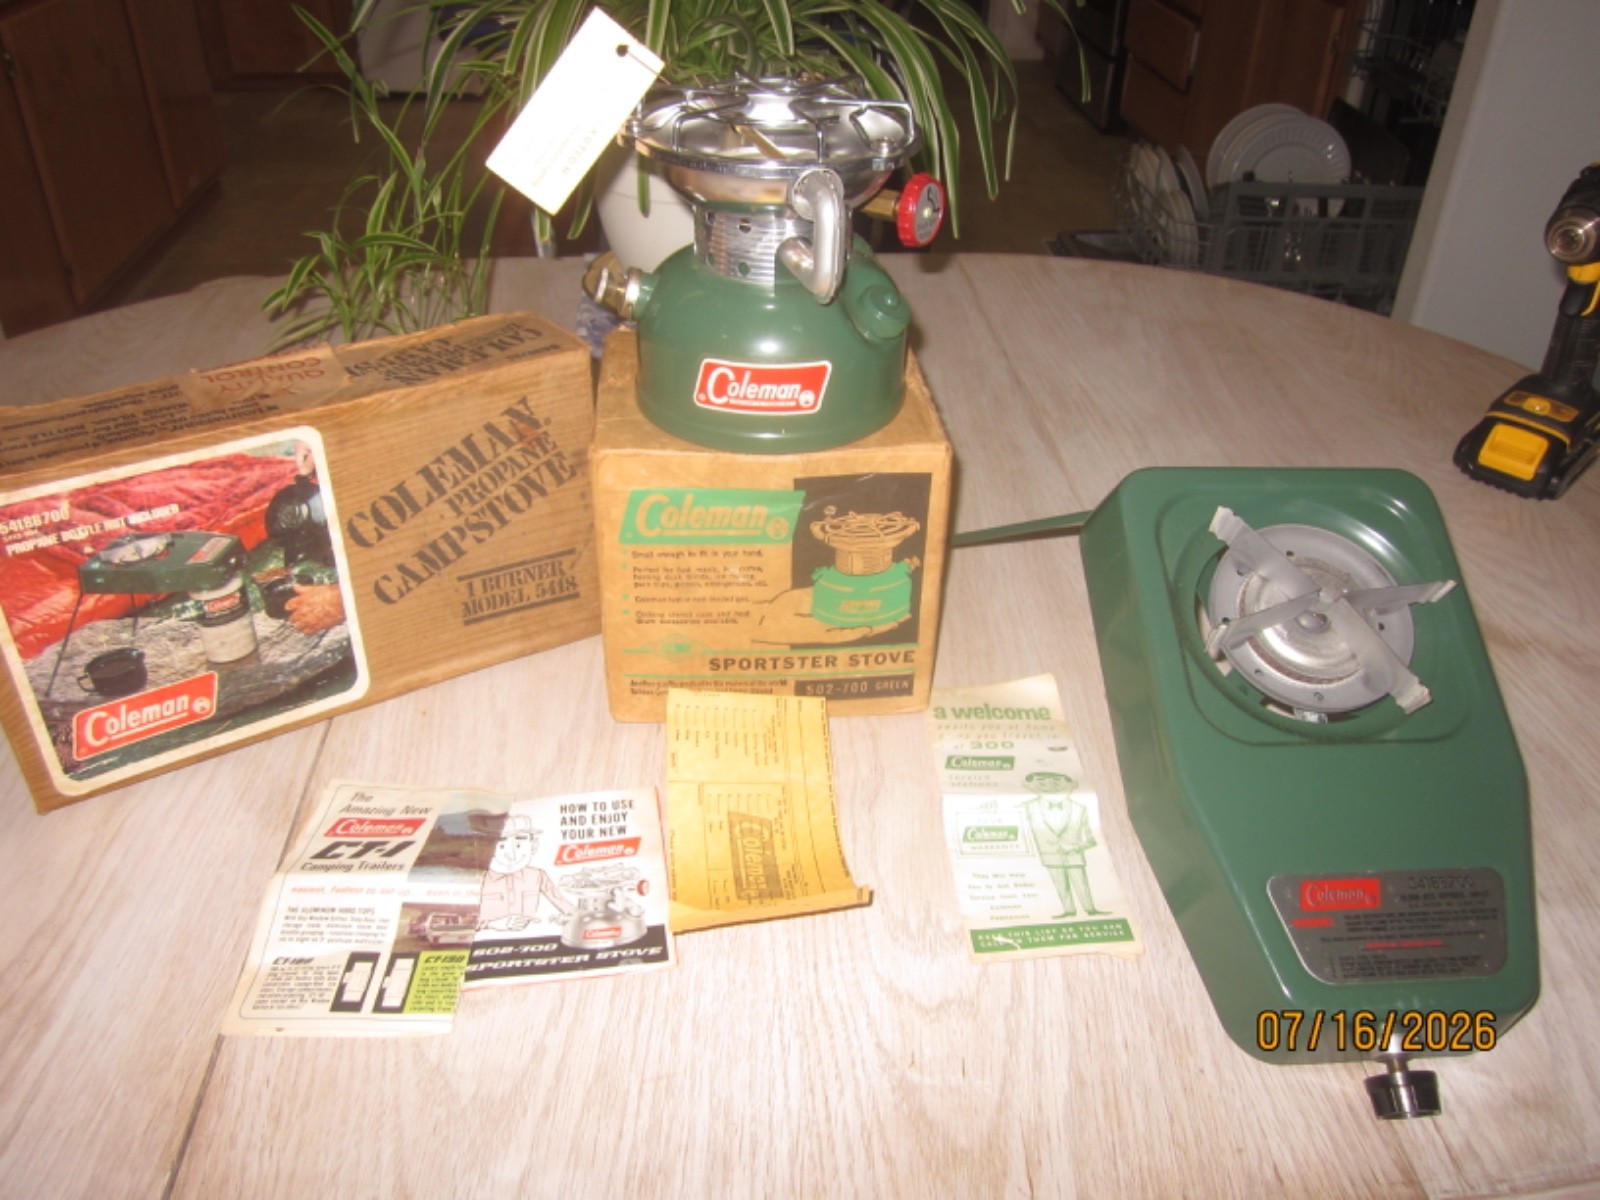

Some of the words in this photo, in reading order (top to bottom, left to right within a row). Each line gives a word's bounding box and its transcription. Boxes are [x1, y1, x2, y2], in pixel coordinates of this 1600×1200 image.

[706, 366, 801, 406] Coleman
[346, 396, 543, 549] COLEMAN
[446, 431, 558, 518] PROPANE
[636, 494, 767, 537] Coleman
[373, 451, 578, 605] CAMPSTOVE
[6, 533, 59, 557] PROPANE
[466, 581, 476, 598] 1
[480, 560, 567, 594] BURNER
[462, 589, 530, 618] MODEL
[535, 576, 578, 599] 5418
[709, 656, 837, 672] SPORTSTER
[848, 650, 915, 667] STOVE
[806, 681, 869, 696] 502-700
[84, 694, 190, 746] Coleman
[933, 706, 948, 721] a
[951, 703, 1052, 721] welcome
[950, 757, 1001, 769] Coleman
[350, 791, 375, 803] The
[560, 803, 588, 814] HOW
[592, 801, 607, 812] TO
[612, 799, 635, 811] USE
[339, 803, 397, 817] Amazing
[400, 804, 433, 815] New
[560, 814, 587, 826] AND
[591, 811, 629, 824] ENJOY
[336, 819, 403, 835] Coleman
[560, 827, 595, 840] YOUR
[600, 825, 628, 838] NEW
[562, 843, 624, 861] Coleman
[735, 820, 770, 890] Coleman
[300, 861, 355, 873] Camping
[358, 860, 406, 871] Trailers
[1306, 883, 1366, 906] Coleman
[1008, 930, 1031, 938] THIS
[1034, 928, 1057, 936] LIST
[1079, 925, 1099, 933] YOU
[1060, 932, 1079, 941] FOR
[1084, 929, 1125, 939] SERVICE
[466, 953, 590, 971] SPORTSTER
[596, 946, 663, 960] STOVE
